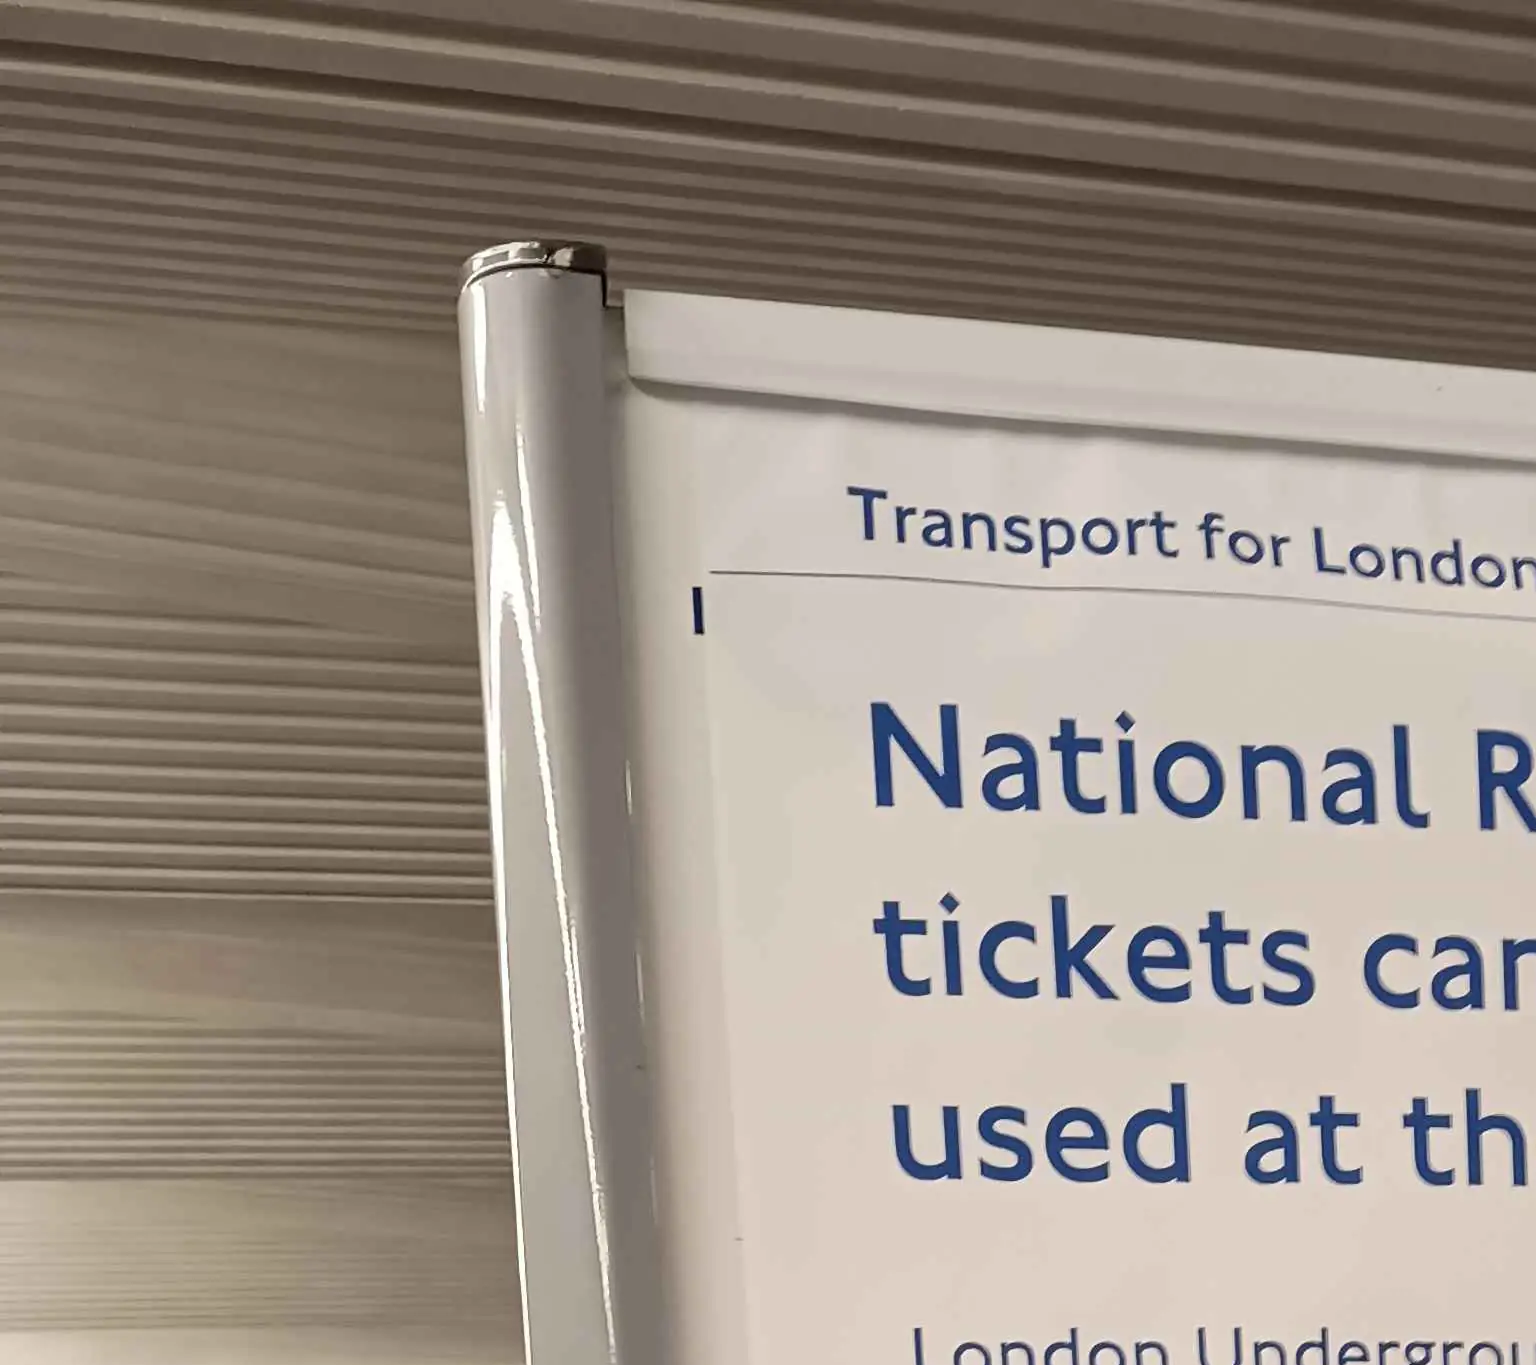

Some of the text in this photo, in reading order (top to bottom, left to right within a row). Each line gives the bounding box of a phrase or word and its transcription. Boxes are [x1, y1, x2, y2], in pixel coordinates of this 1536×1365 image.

[846, 486, 1179, 566] Transport
[1198, 512, 1291, 567] for
[871, 702, 1430, 828] National
[873, 893, 1315, 1006] tickets
[892, 1083, 1190, 1183] used
[1245, 1095, 1363, 1185] at
